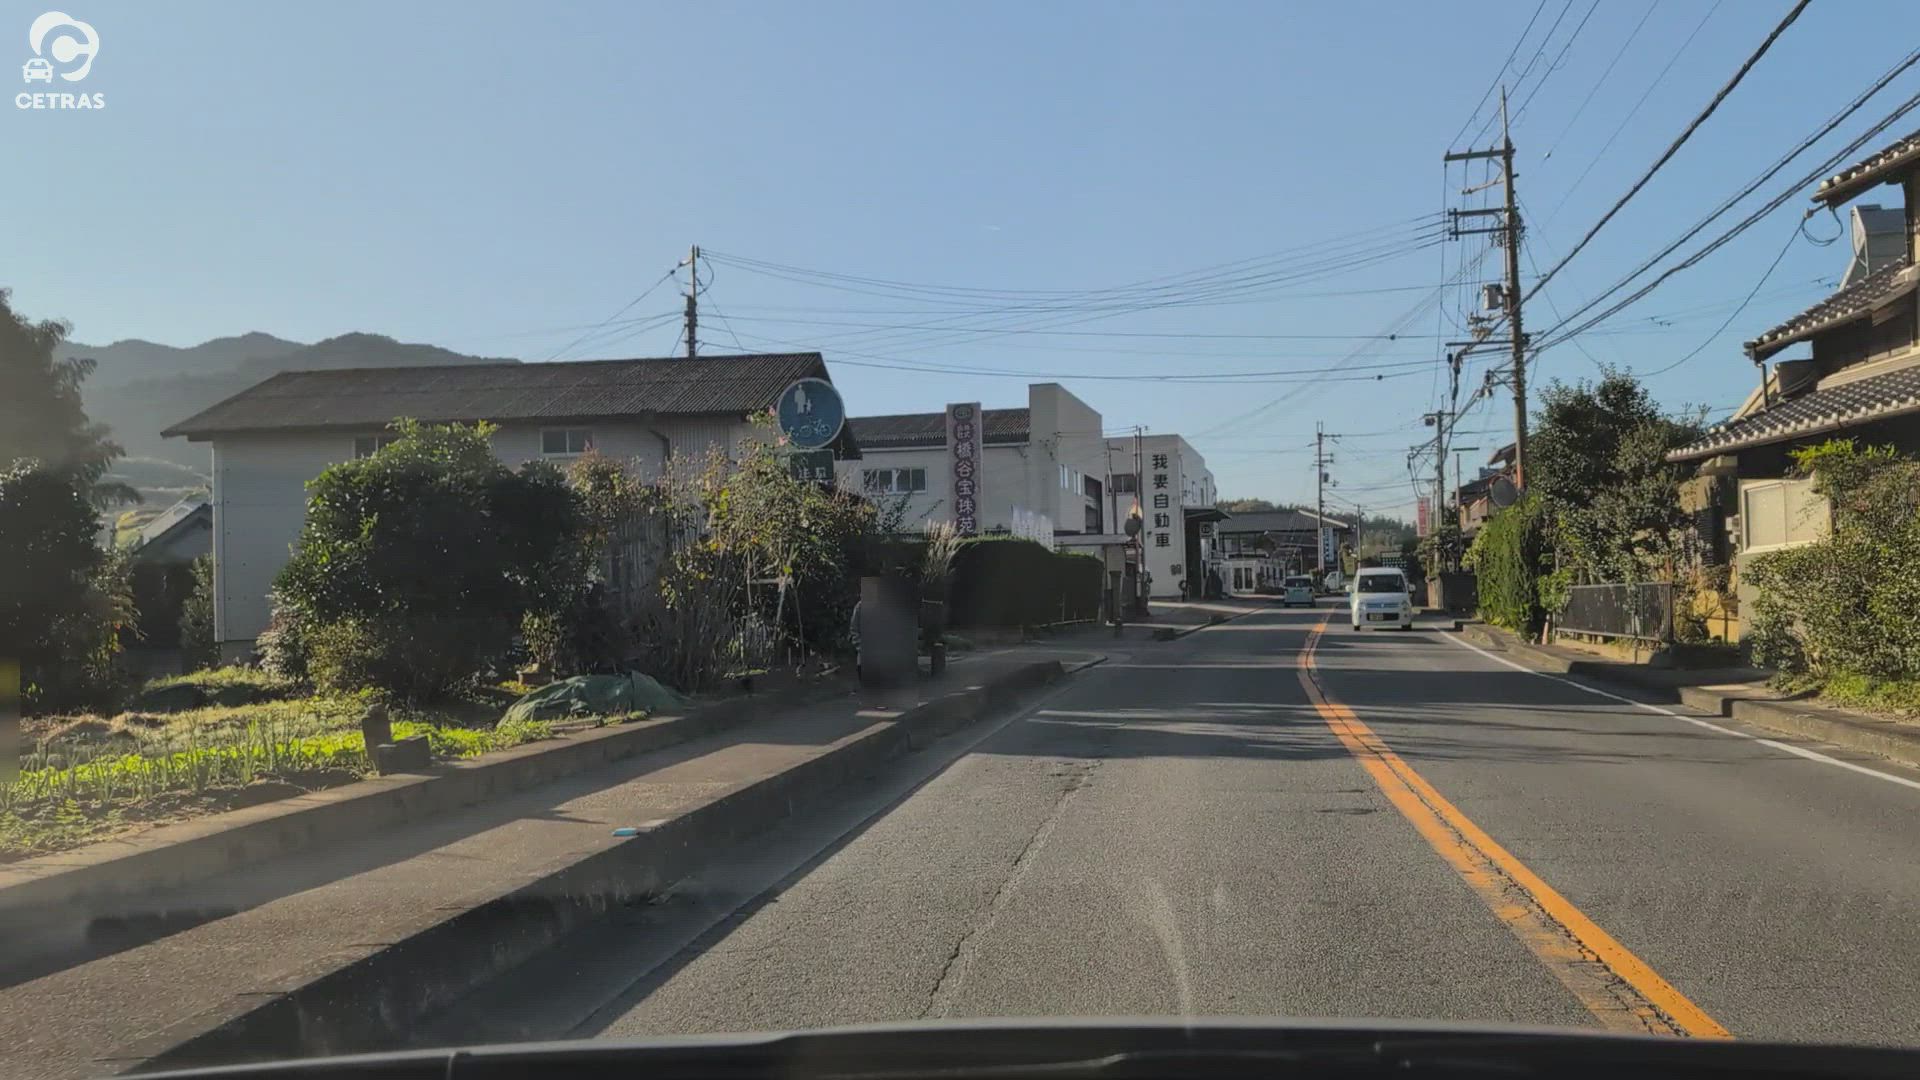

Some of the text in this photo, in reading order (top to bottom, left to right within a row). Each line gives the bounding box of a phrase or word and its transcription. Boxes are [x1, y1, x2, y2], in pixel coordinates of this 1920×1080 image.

[1152, 453, 1170, 548] 我妻自動車
